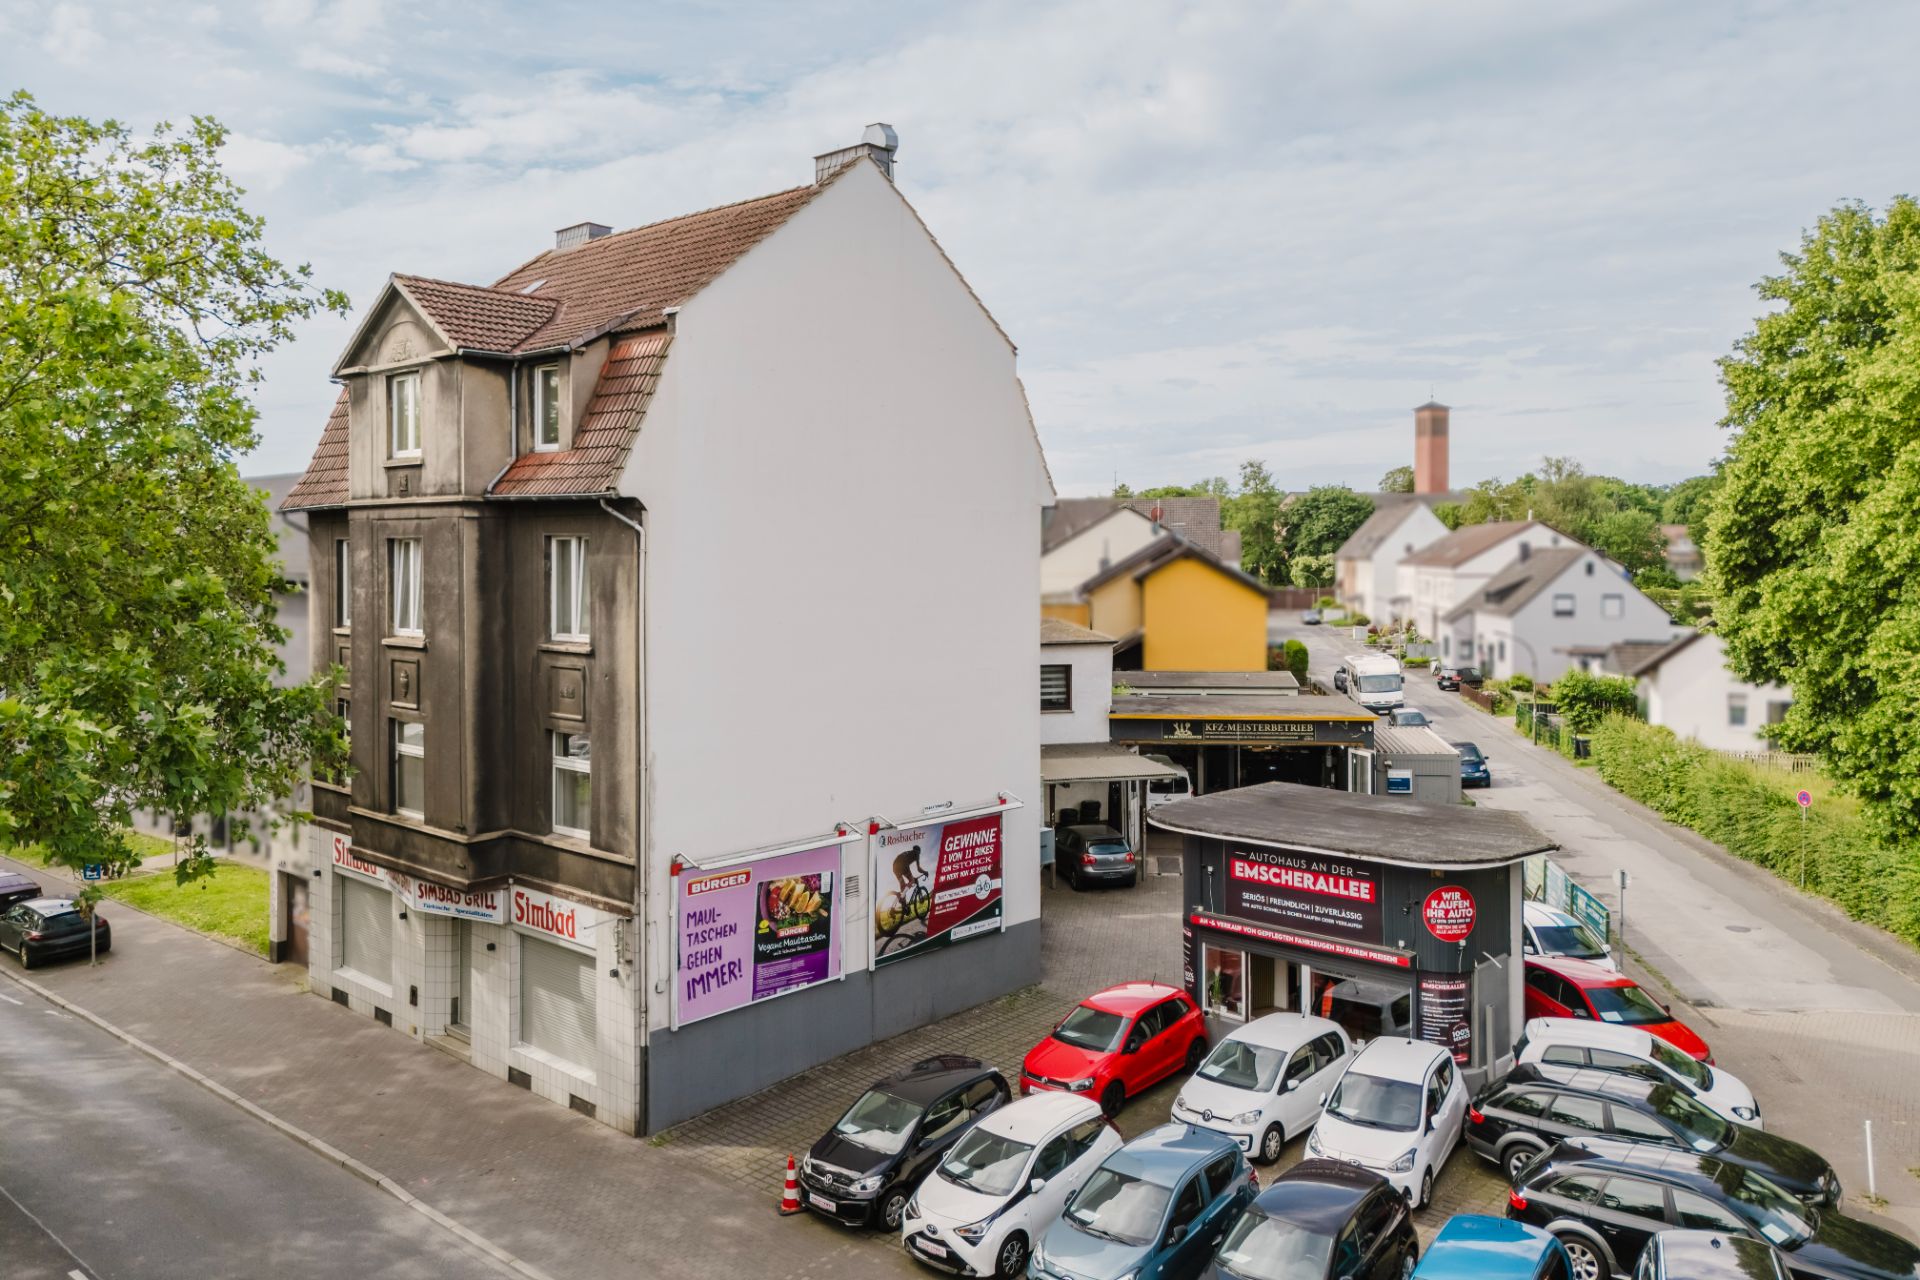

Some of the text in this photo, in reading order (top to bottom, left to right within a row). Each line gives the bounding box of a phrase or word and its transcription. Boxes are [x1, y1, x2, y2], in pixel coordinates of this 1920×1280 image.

[1205, 723, 1314, 732] KFZ-MEISTERBETRIEB
[887, 830, 926, 846] Rosbacher
[944, 827, 998, 852] GEWINNE
[943, 854, 947, 864] 1
[948, 851, 963, 863] VON
[974, 844, 995, 857] BIKES
[952, 855, 992, 870] STORCK
[1249, 851, 1354, 877] AUTOHAUS AN DER
[691, 874, 747, 893] BÜRGER
[1235, 861, 1370, 899] EMSCHERALLEE
[418, 883, 462, 904] SIMBAD
[464, 892, 497, 910] GRILL
[1242, 892, 1363, 920] SERIÖS FREUNDLICH ZUVERLÄSSIG
[1431, 900, 1470, 909] KAUFEN
[1441, 891, 1461, 900] WIR
[515, 891, 576, 939] Simbad
[686, 907, 722, 928] MAUL-
[1426, 908, 1473, 918] IHR AUTO
[687, 923, 737, 947] TASCHEN
[780, 926, 808, 937] BÜRGER
[1216, 921, 1242, 931] VERKAUF
[1243, 926, 1257, 935] VON
[1257, 929, 1294, 942] GEPFLEGTEN
[1294, 936, 1335, 950] FAHRZEUGEN
[1345, 947, 1369, 957] FAIREN
[758, 932, 827, 953] Vegane Maultaschen
[687, 945, 722, 970] GEHEN
[687, 958, 743, 1002] IMMER!
